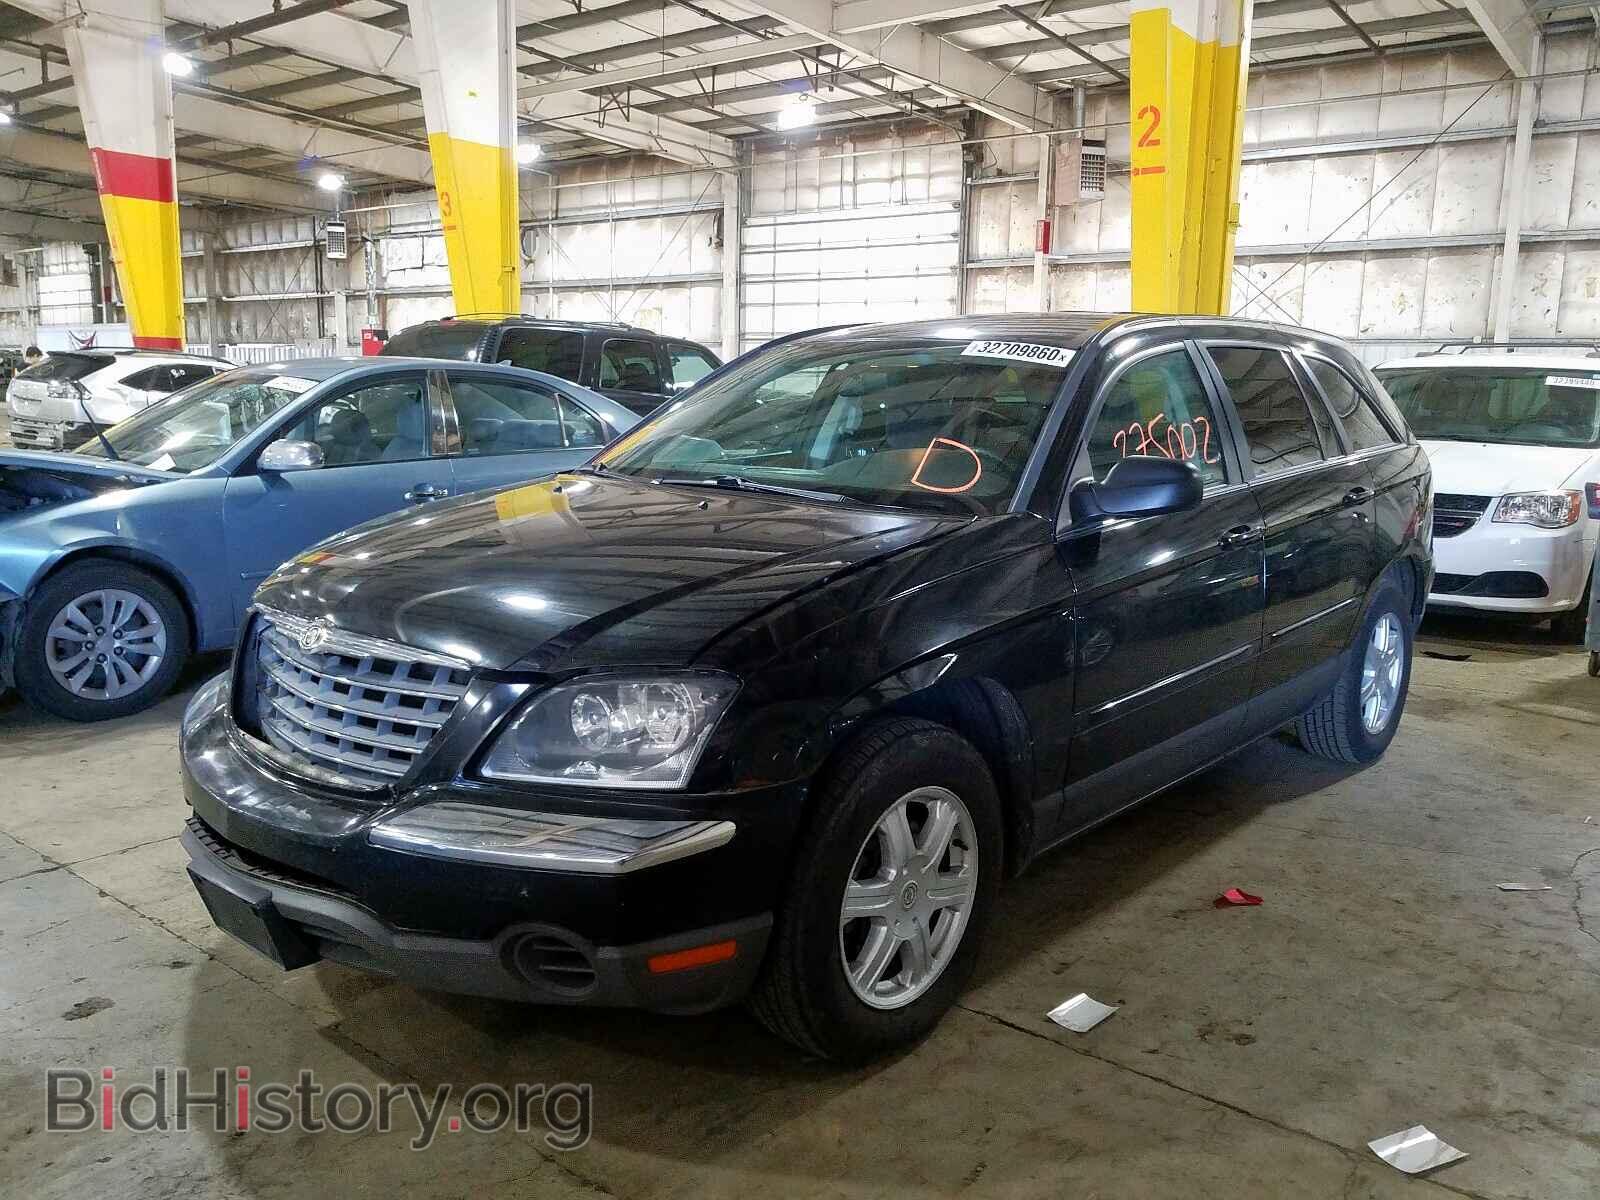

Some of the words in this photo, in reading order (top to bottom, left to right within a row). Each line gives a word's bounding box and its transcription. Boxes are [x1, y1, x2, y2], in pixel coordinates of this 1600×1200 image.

[1137, 105, 1161, 148] 2
[440, 191, 452, 217] 3
[911, 437, 981, 493] D
